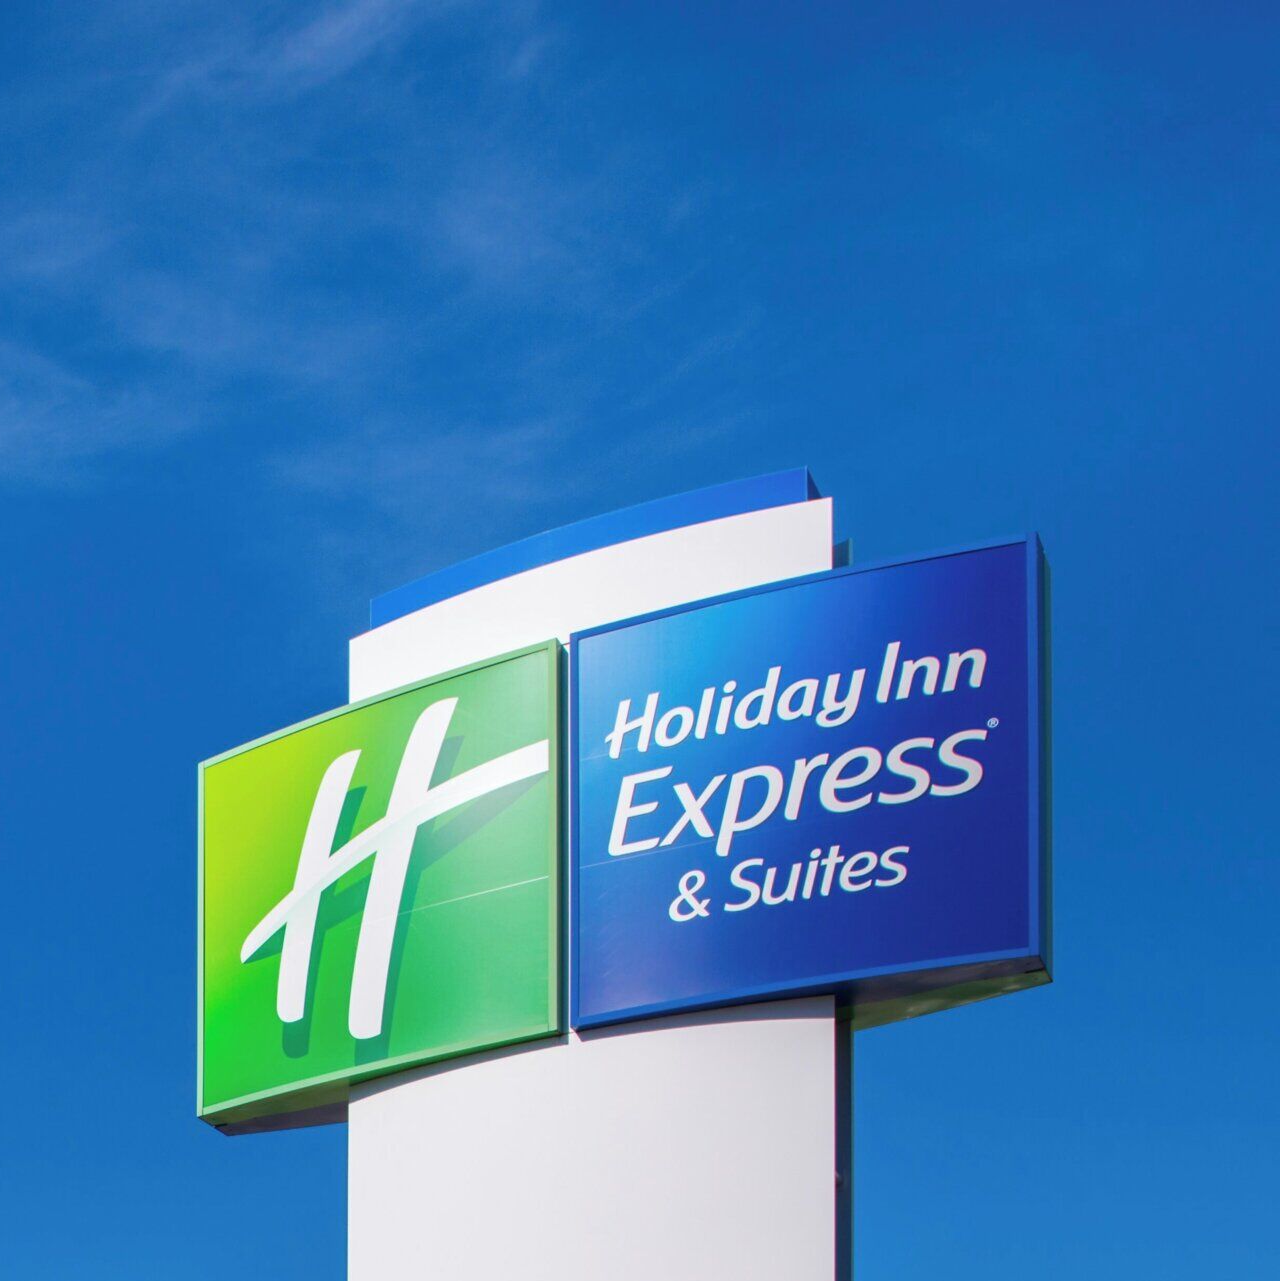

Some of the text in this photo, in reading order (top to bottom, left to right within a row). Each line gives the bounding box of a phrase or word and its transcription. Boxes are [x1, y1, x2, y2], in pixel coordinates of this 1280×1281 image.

[604, 640, 988, 760] Holiday Inn
[607, 729, 989, 858] Express
[668, 844, 910, 923] & Suites
